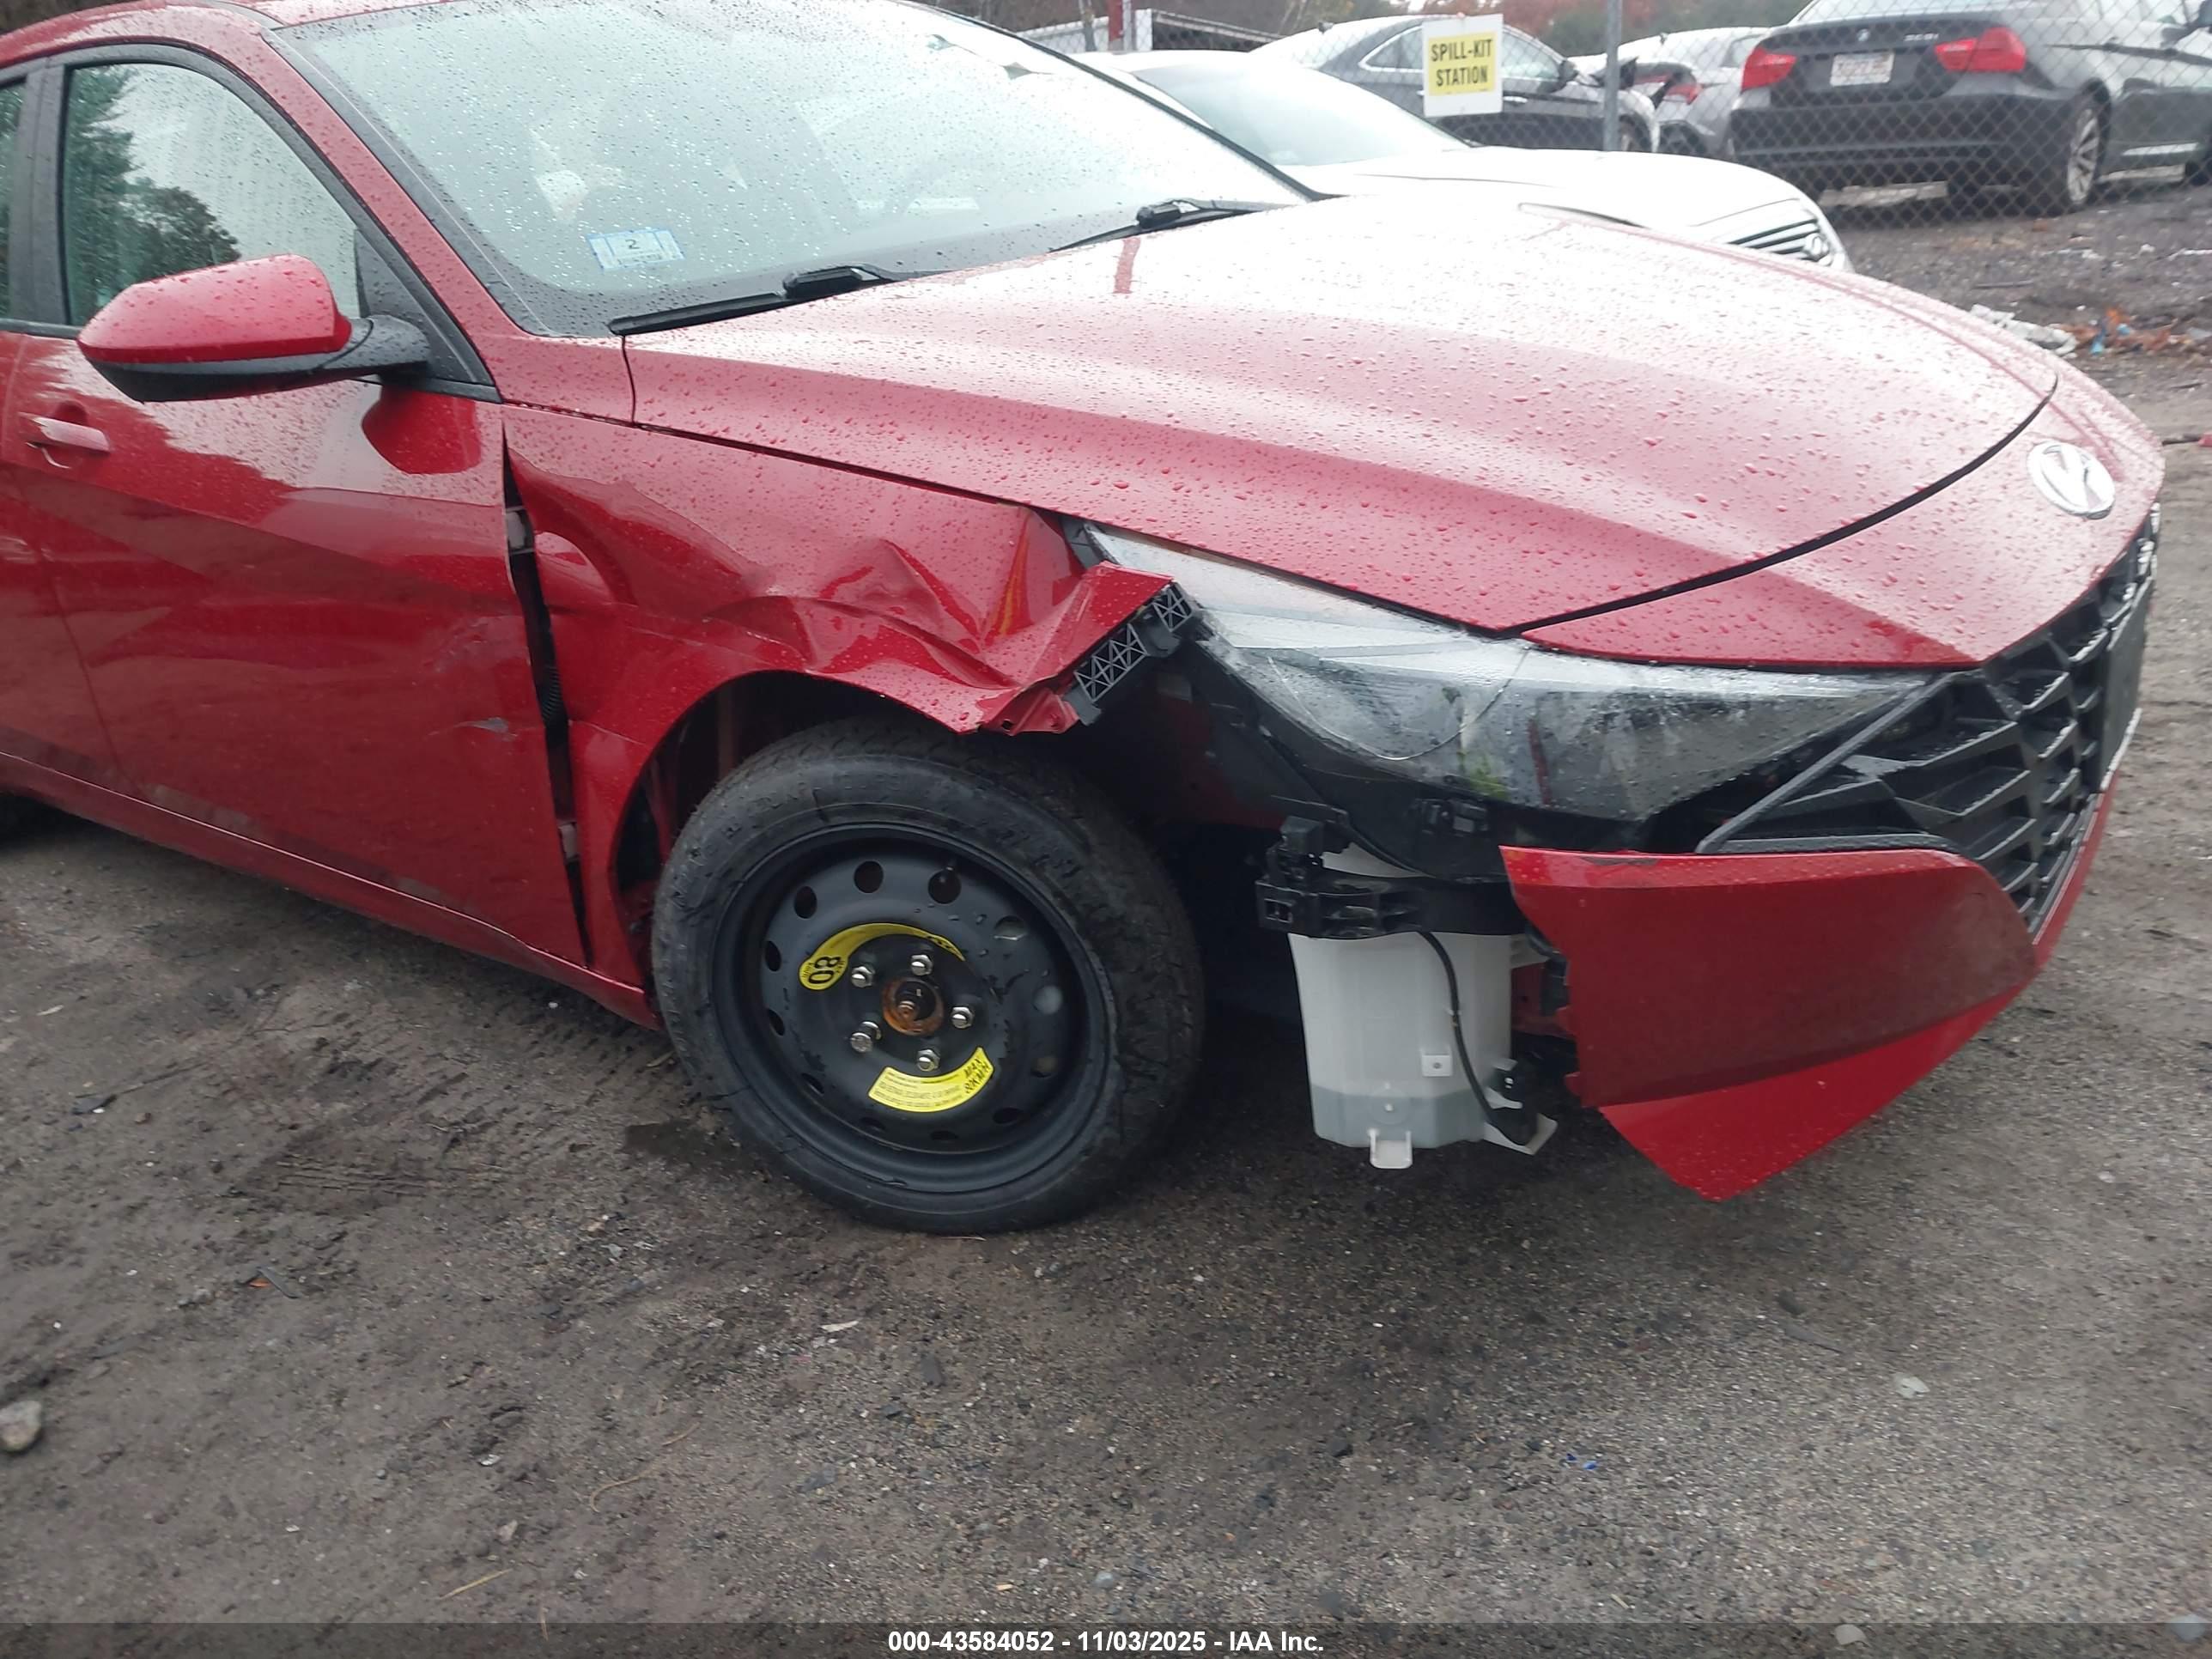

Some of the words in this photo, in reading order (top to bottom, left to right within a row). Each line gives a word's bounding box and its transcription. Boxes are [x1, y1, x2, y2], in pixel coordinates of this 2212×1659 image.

[1431, 39, 1492, 62] SPILL-KIT
[1437, 65, 1488, 87] STATION
[625, 239, 641, 250] 2
[808, 956, 842, 985] 80
